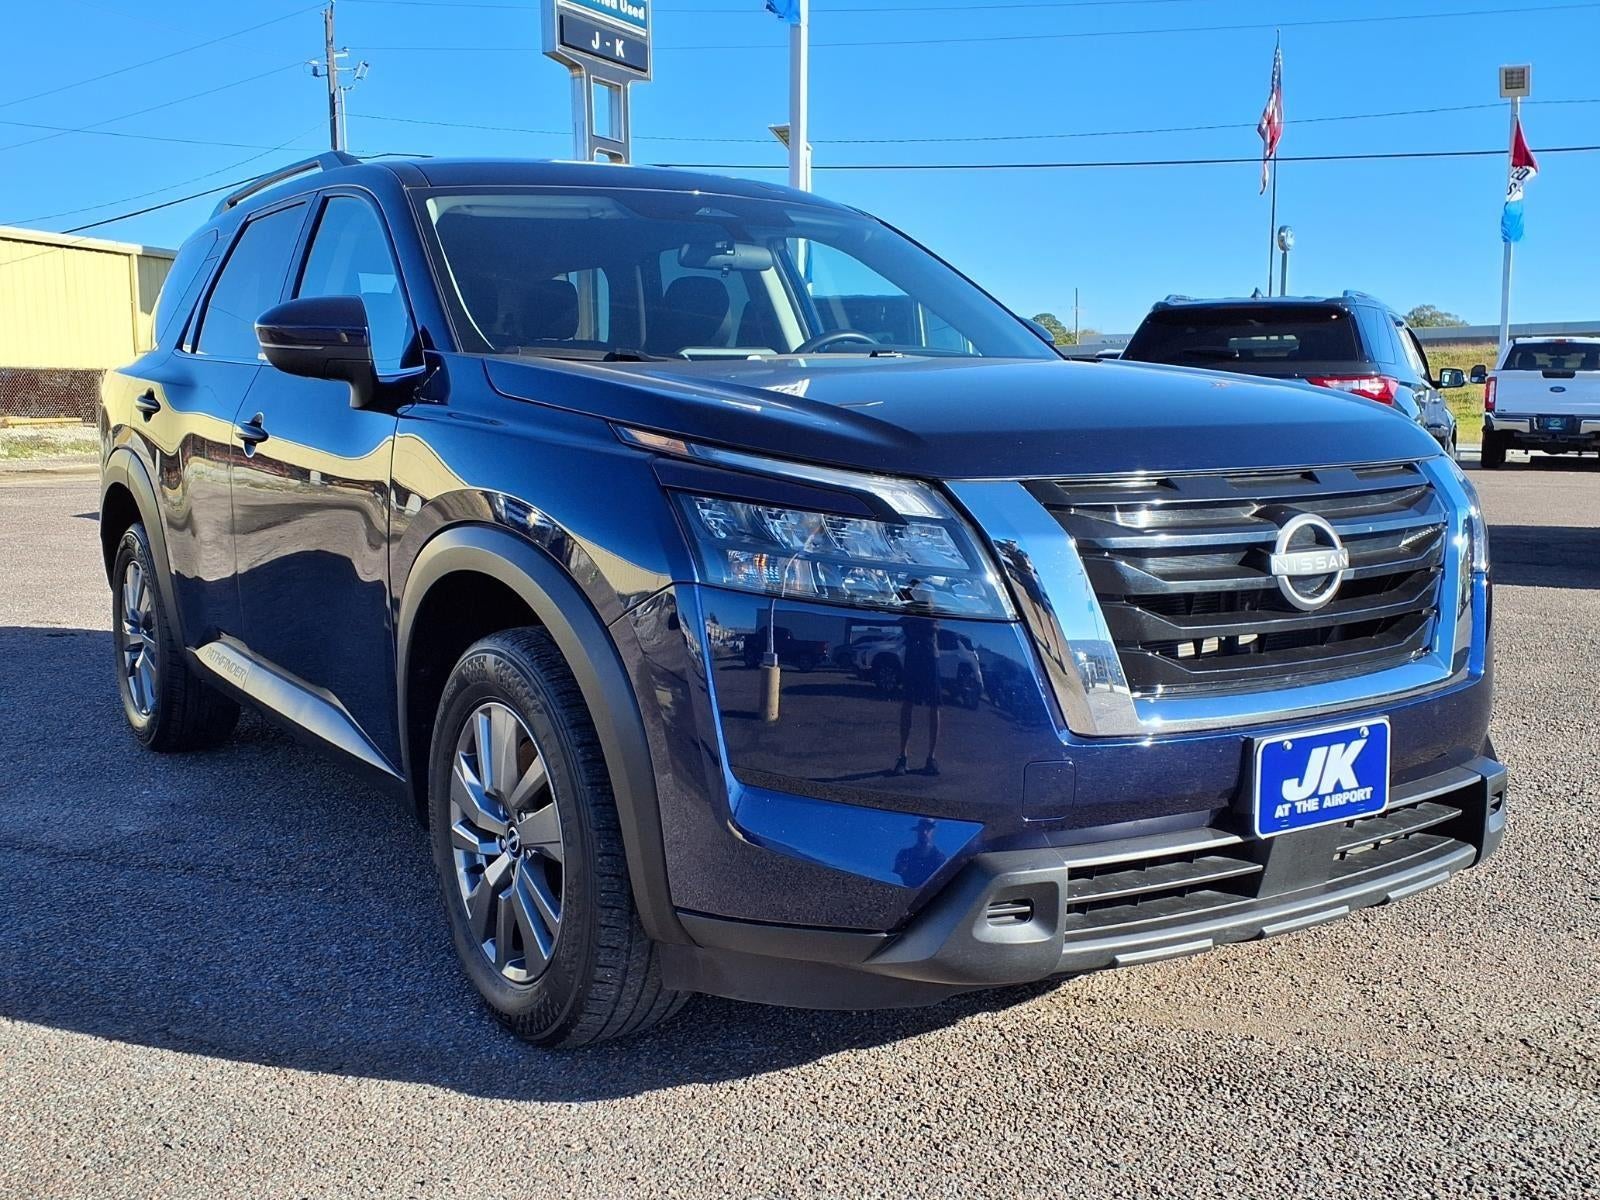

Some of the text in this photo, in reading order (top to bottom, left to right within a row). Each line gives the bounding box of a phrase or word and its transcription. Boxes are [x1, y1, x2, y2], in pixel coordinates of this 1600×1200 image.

[620, 0, 645, 20] Used
[1274, 553, 1349, 572] NISSAN
[1281, 739, 1368, 802] JK
[1274, 786, 1374, 819] AT THE AIRPORT
